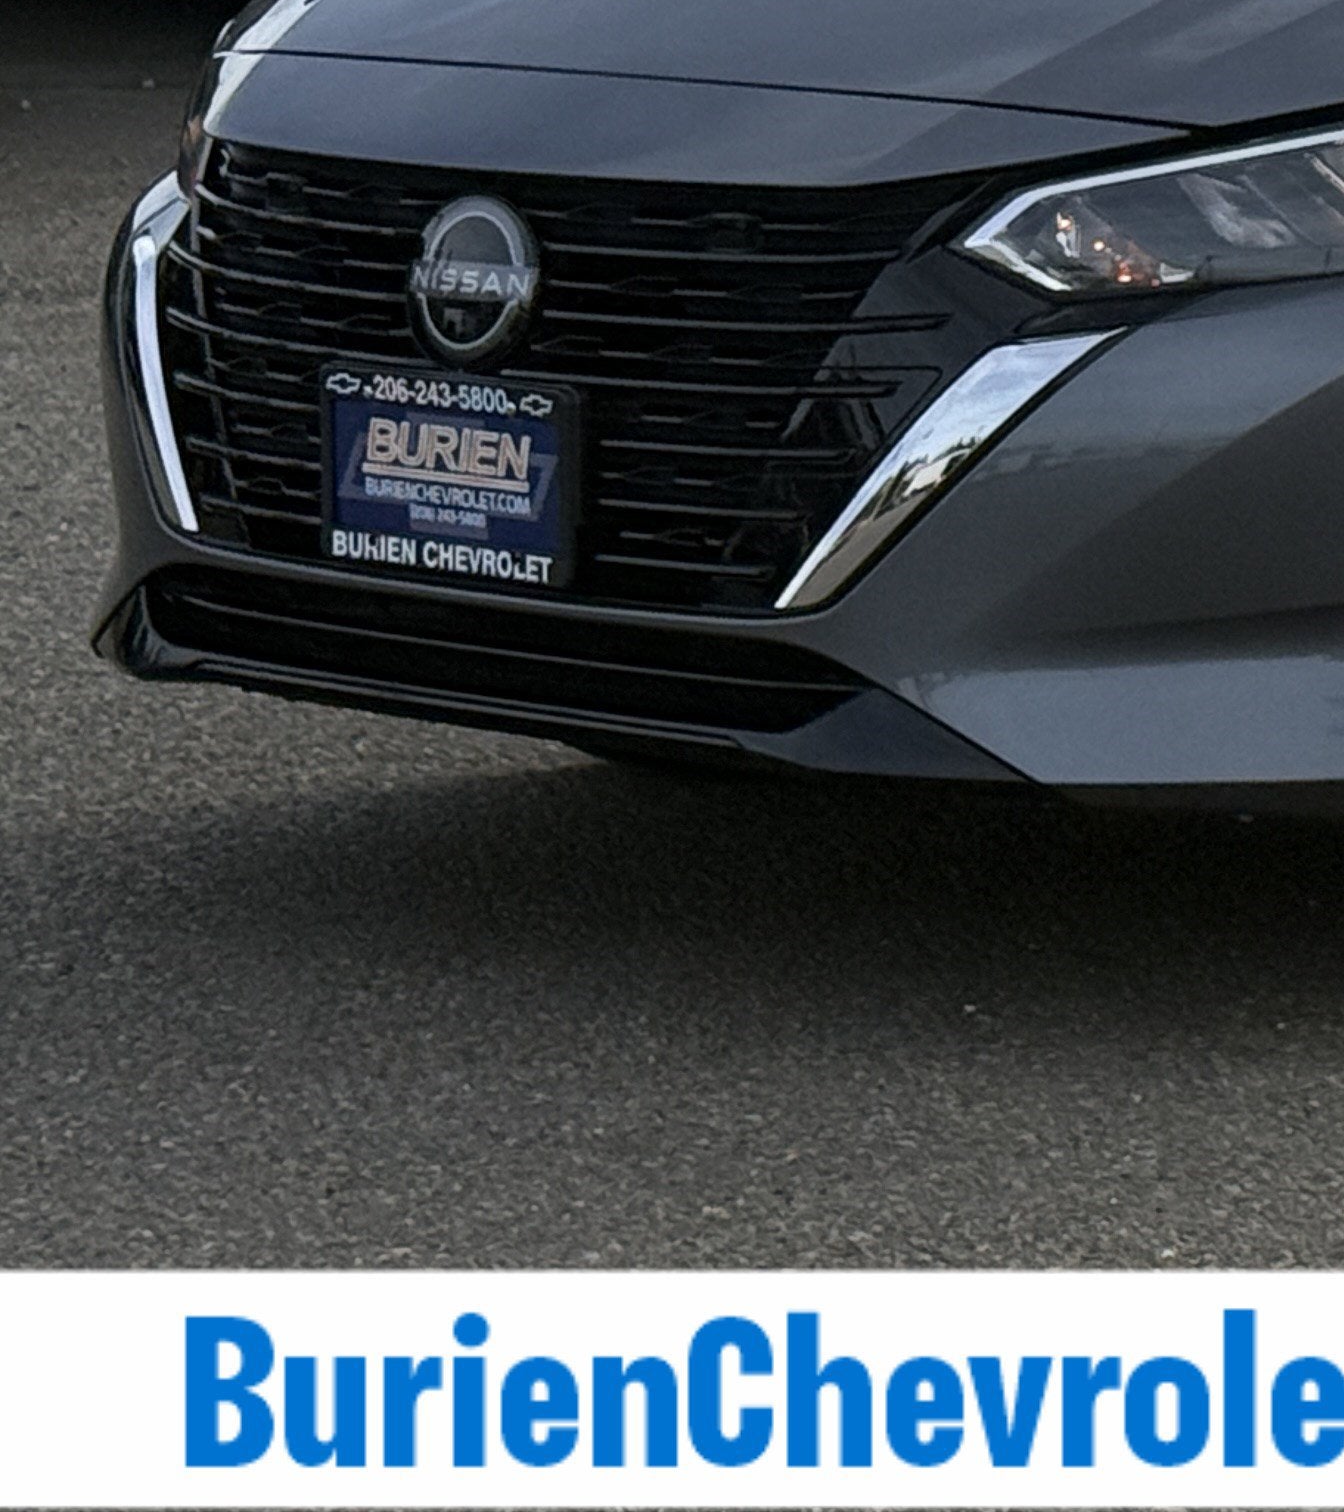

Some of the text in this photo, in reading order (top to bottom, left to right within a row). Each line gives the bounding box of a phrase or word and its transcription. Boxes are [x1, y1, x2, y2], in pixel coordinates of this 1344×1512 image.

[411, 266, 531, 297] NISSAN
[372, 374, 508, 414] 206-243-5800
[366, 417, 532, 480] BURIEN
[331, 529, 417, 566] BURIEN
